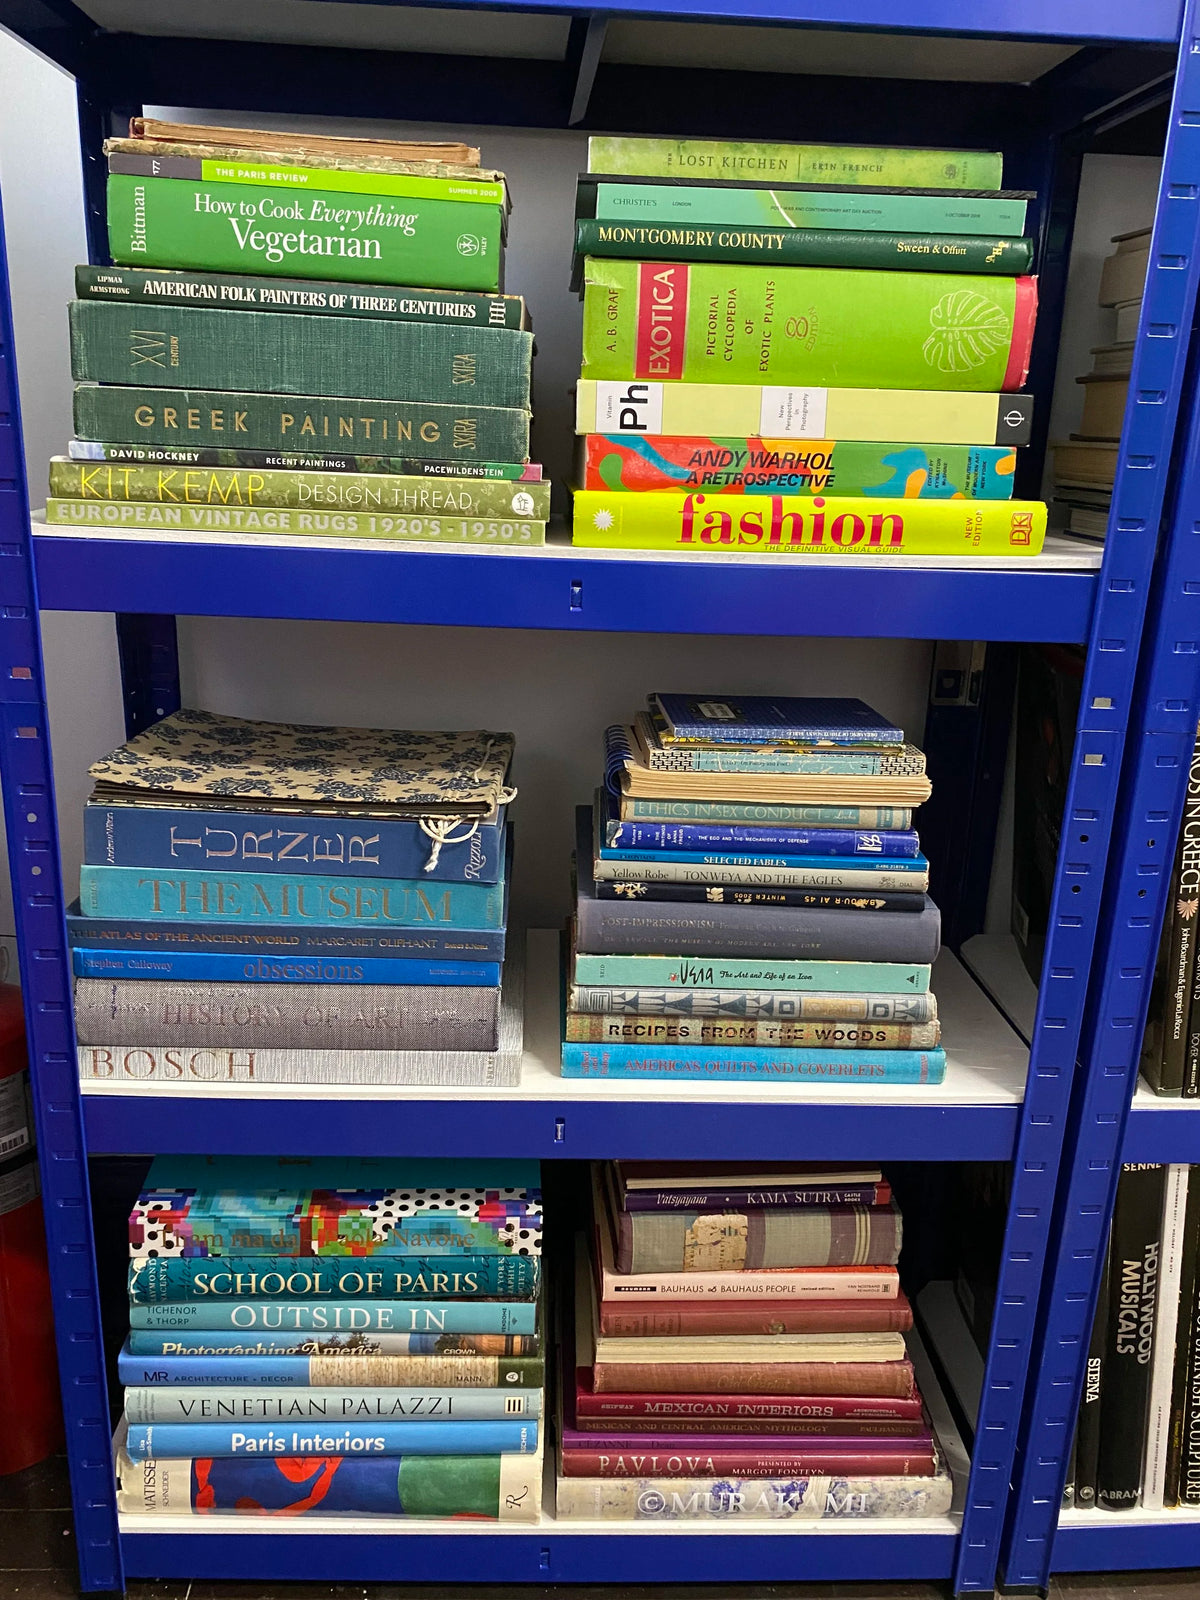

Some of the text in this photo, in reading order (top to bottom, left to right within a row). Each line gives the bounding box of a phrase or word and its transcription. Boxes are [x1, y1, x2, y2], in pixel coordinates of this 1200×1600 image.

[679, 155, 883, 173] LOST KITCHEN FRENCH
[216, 167, 234, 178] THE
[238, 169, 266, 180] PARIS
[269, 171, 309, 183] REVIEW
[448, 187, 478, 196] SUMMER
[613, 198, 657, 207] CHRISTIE'S
[130, 186, 147, 253] Bittman
[194, 193, 419, 237] How to Cook Everything
[228, 217, 383, 263] Vegetarian
[598, 227, 785, 249] MONTGOMERY COUNTY
[897, 242, 930, 254] Sween
[89, 285, 130, 295] ARMSTRONG
[97, 275, 123, 284] LIPMAN
[143, 280, 477, 319] AMERICAN FOLK PAINTERS OF THREE CENTURIES
[608, 289, 619, 321] GRAF
[649, 268, 675, 374] EXOTICA
[706, 294, 719, 356] PICTORIAL
[724, 288, 737, 362] CYCLOPEDIA
[745, 319, 754, 335] OF
[759, 280, 775, 372] EXOTIC PLANTS
[452, 352, 477, 386] SKIRA
[619, 384, 649, 431] Ph
[785, 392, 793, 431] Perspectives
[800, 392, 809, 431] Photography
[134, 405, 441, 443] GREEK PAINTING
[453, 418, 478, 450] SKIRA
[110, 449, 199, 462] DAVID HOCKNEY
[266, 457, 346, 468] RECENT PAINTINGS
[688, 449, 835, 470] ANDY WARHOL
[424, 465, 504, 477] PACEWILDENSTEIN
[685, 471, 836, 487] A RETROSPECTIVE
[80, 466, 473, 510] KIT KEMP DESIGN THREAD
[57, 503, 532, 540] EUROPEAN VINTAGE RUGS 1920'S 1950'S
[676, 493, 905, 547] fashion
[964, 516, 973, 539] NEW
[973, 509, 982, 547] EDITION
[784, 545, 835, 553] DEFINITIVE
[838, 545, 872, 553] VISUAL
[874, 546, 904, 554] GUIDE
[638, 802, 825, 820] ETHICS IN SEX CONDUCT
[170, 825, 380, 865] TURNER
[703, 855, 787, 867] SELECTED FABLES
[1179, 821, 1200, 894] GREECE
[612, 867, 843, 886] Yellow Robe TONWEYA AND THE EAGLES
[137, 878, 242, 916] THE
[250, 882, 453, 922] MUSEUM
[100, 930, 299, 945] ATLAS OF THE ANCIENT WORLD
[307, 936, 376, 947] MARGARET
[379, 938, 438, 950] OLIPHANT
[84, 958, 173, 973] Stephen Calloway
[243, 957, 364, 980] obsessions
[719, 970, 749, 979] The Art
[162, 1003, 286, 1027] HISTORY
[608, 1024, 887, 1042] RECIPES FROM THE WOODS
[86, 1048, 257, 1079] BOSCH
[624, 1059, 886, 1077] AMERICA'S QUILTS AND COVERLETS
[656, 1191, 841, 1207] Vatsyayana KAMA SUTRA
[391, 1228, 476, 1248] Navone
[193, 1272, 479, 1295] SCHOOL OF PARIS
[660, 1285, 704, 1293] BAUHAUS
[720, 1285, 764, 1293] BAUHAUS
[765, 1285, 797, 1293] PEOPLE
[1115, 1259, 1142, 1355] MUSICALS
[1136, 1241, 1160, 1365] HOLLYWOOD
[156, 1317, 190, 1326] THORP
[231, 1305, 449, 1330] OUTSIDE IN
[143, 1371, 169, 1383] MR
[174, 1375, 249, 1383] ARCHITECTURE
[1085, 1357, 1101, 1404] SIENA
[178, 1398, 327, 1417] VENETIAN
[341, 1396, 455, 1415] PALAZZI
[644, 1402, 834, 1417] MEXICAN INTERIORS
[586, 1422, 829, 1433] MEXICAN AND CENTRAL AMERICAN MYTHOLOGY
[231, 1431, 385, 1452] Paris Interiors
[598, 1455, 717, 1472] PAVLOVA
[143, 1459, 157, 1512] MATISSE
